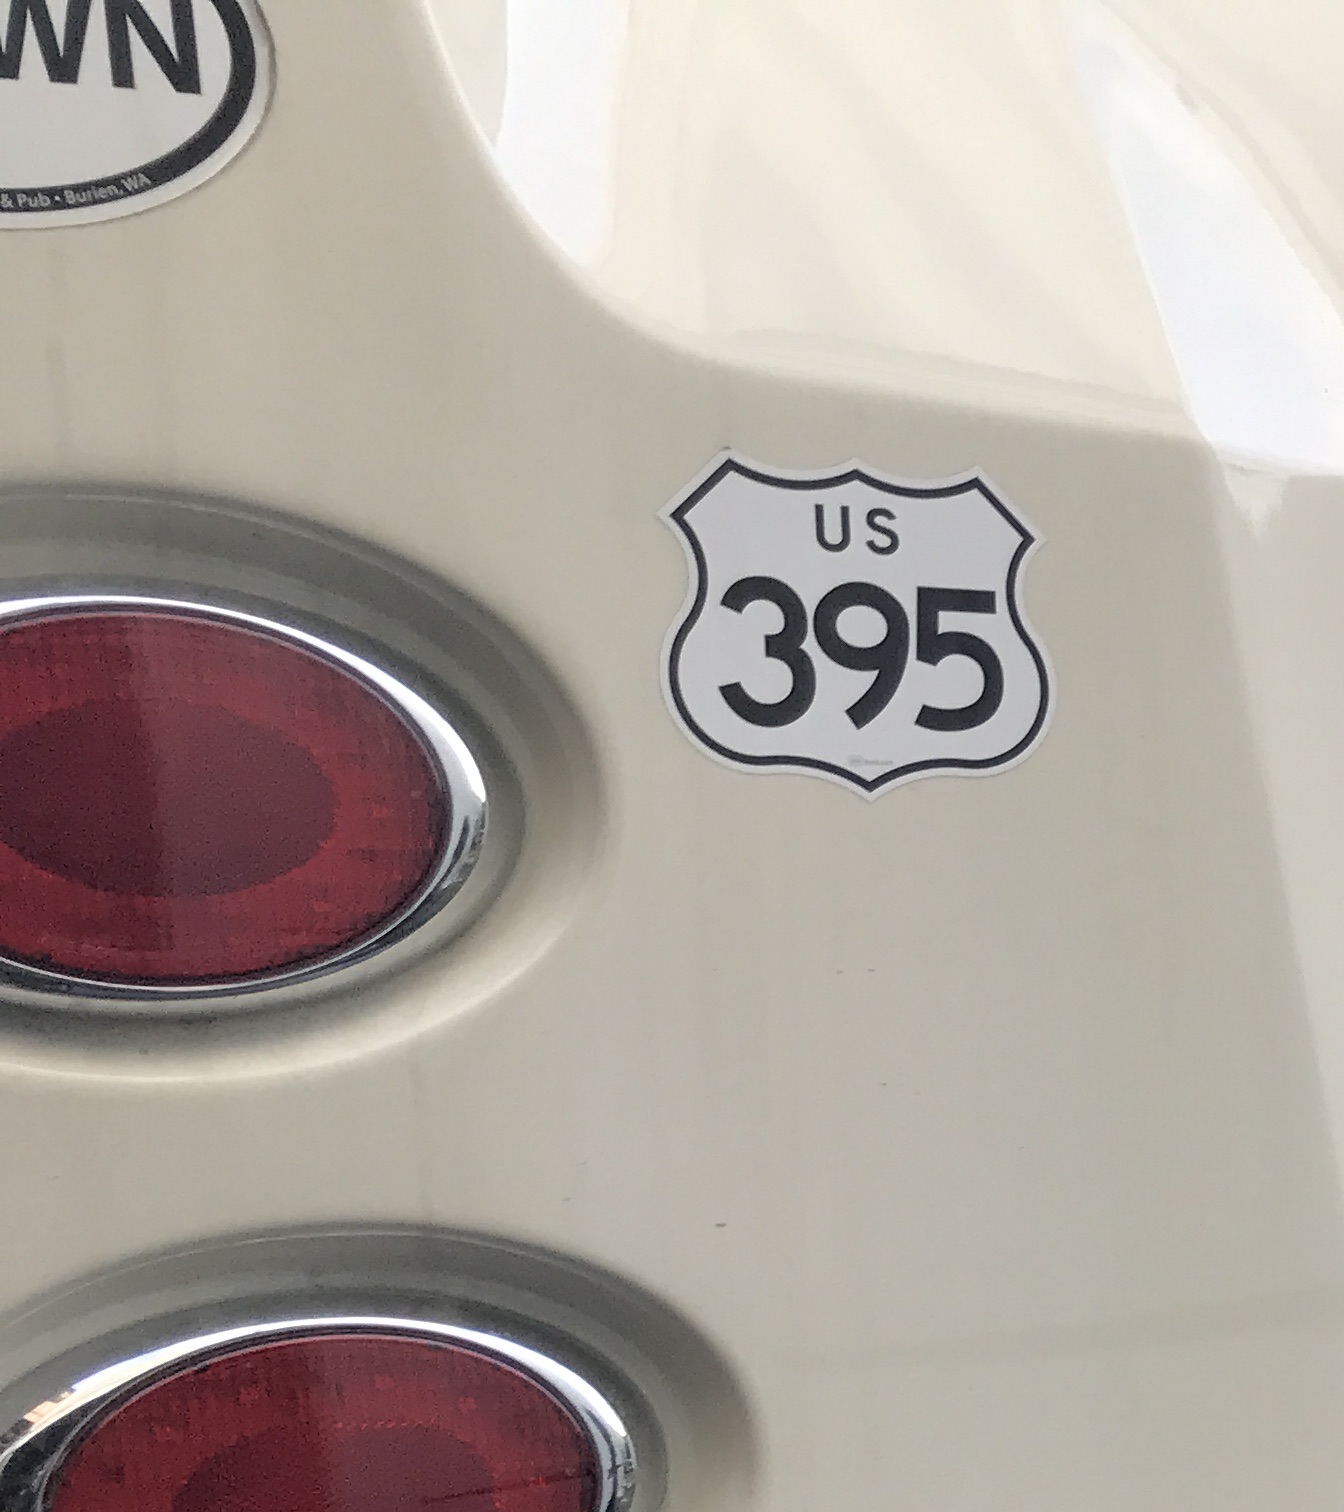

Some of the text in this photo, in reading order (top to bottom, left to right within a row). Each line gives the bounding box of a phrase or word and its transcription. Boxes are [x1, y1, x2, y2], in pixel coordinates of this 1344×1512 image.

[16, 193, 51, 208] Pub
[121, 172, 151, 191] WA
[814, 503, 900, 556] US
[718, 575, 1005, 732] 395
